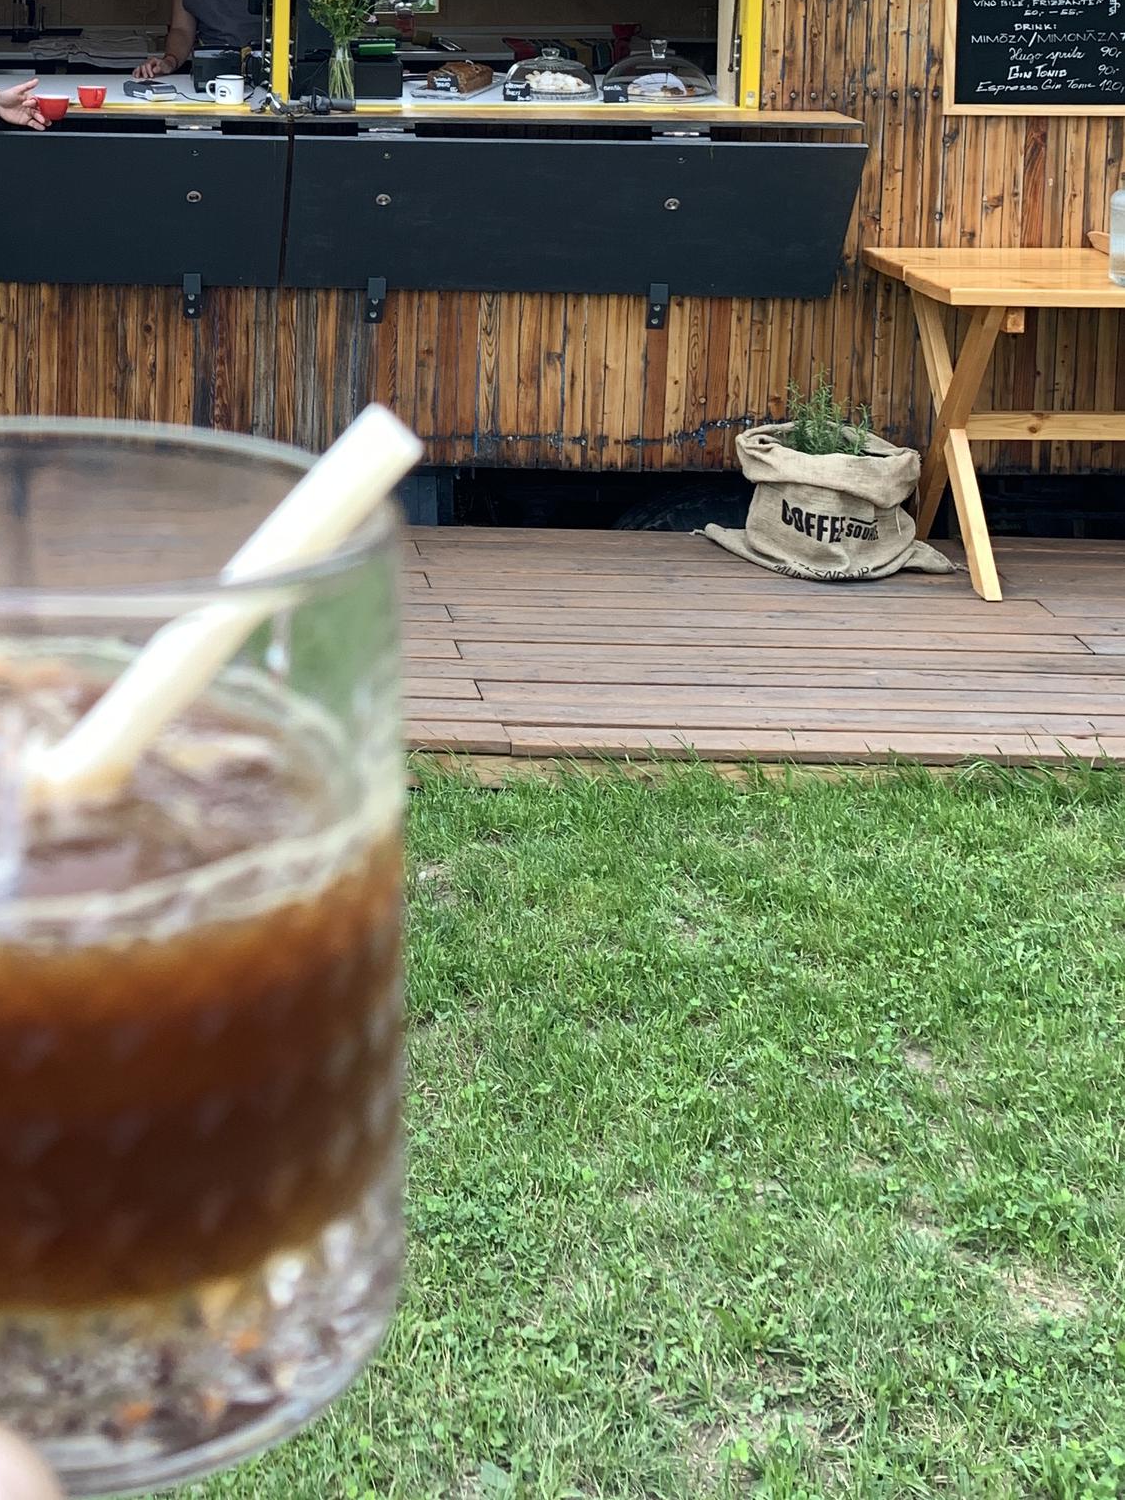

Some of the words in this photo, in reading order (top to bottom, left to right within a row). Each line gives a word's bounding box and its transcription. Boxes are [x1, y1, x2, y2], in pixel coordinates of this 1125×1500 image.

[1009, 47, 1044, 64] Hugo
[975, 80, 1039, 96] Espresso
[1040, 78, 1062, 91] Gin
